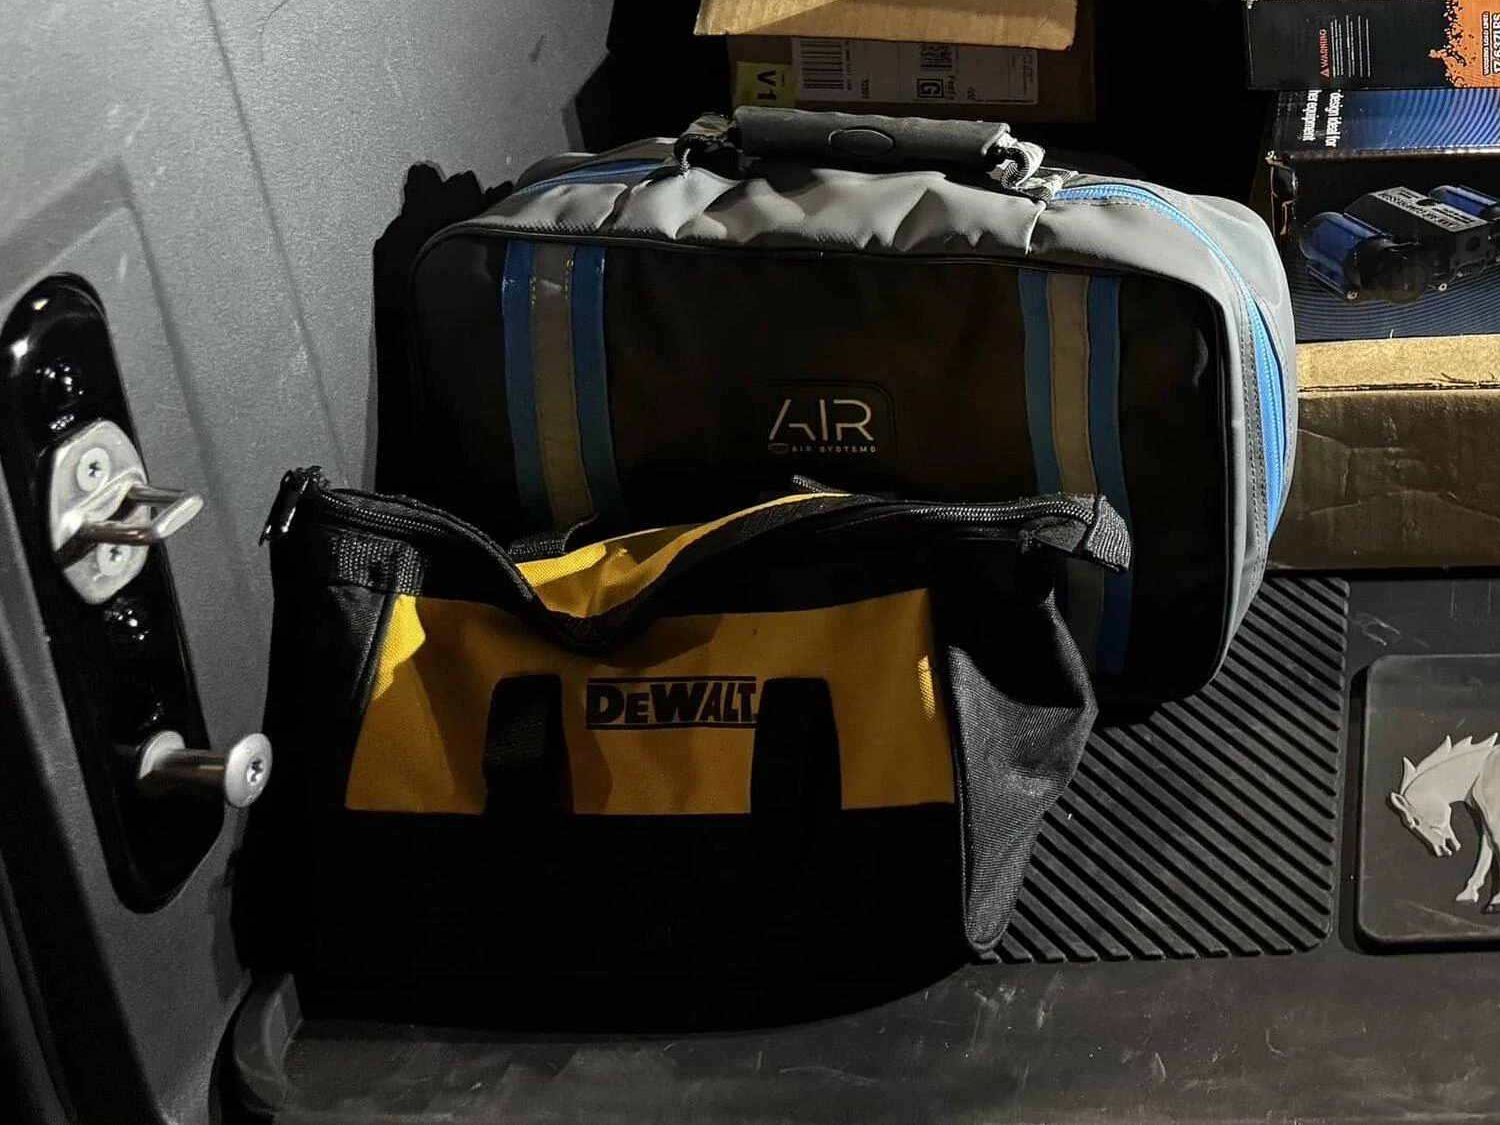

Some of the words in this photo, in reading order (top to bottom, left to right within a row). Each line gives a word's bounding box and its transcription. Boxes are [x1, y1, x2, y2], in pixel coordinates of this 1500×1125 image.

[1319, 29, 1329, 68] WARNING
[920, 82, 941, 95] G
[1324, 92, 1344, 116] design
[1301, 102, 1320, 142] equipment
[1326, 117, 1342, 135] ideal
[1325, 135, 1341, 147] for
[768, 398, 875, 442] AIR
